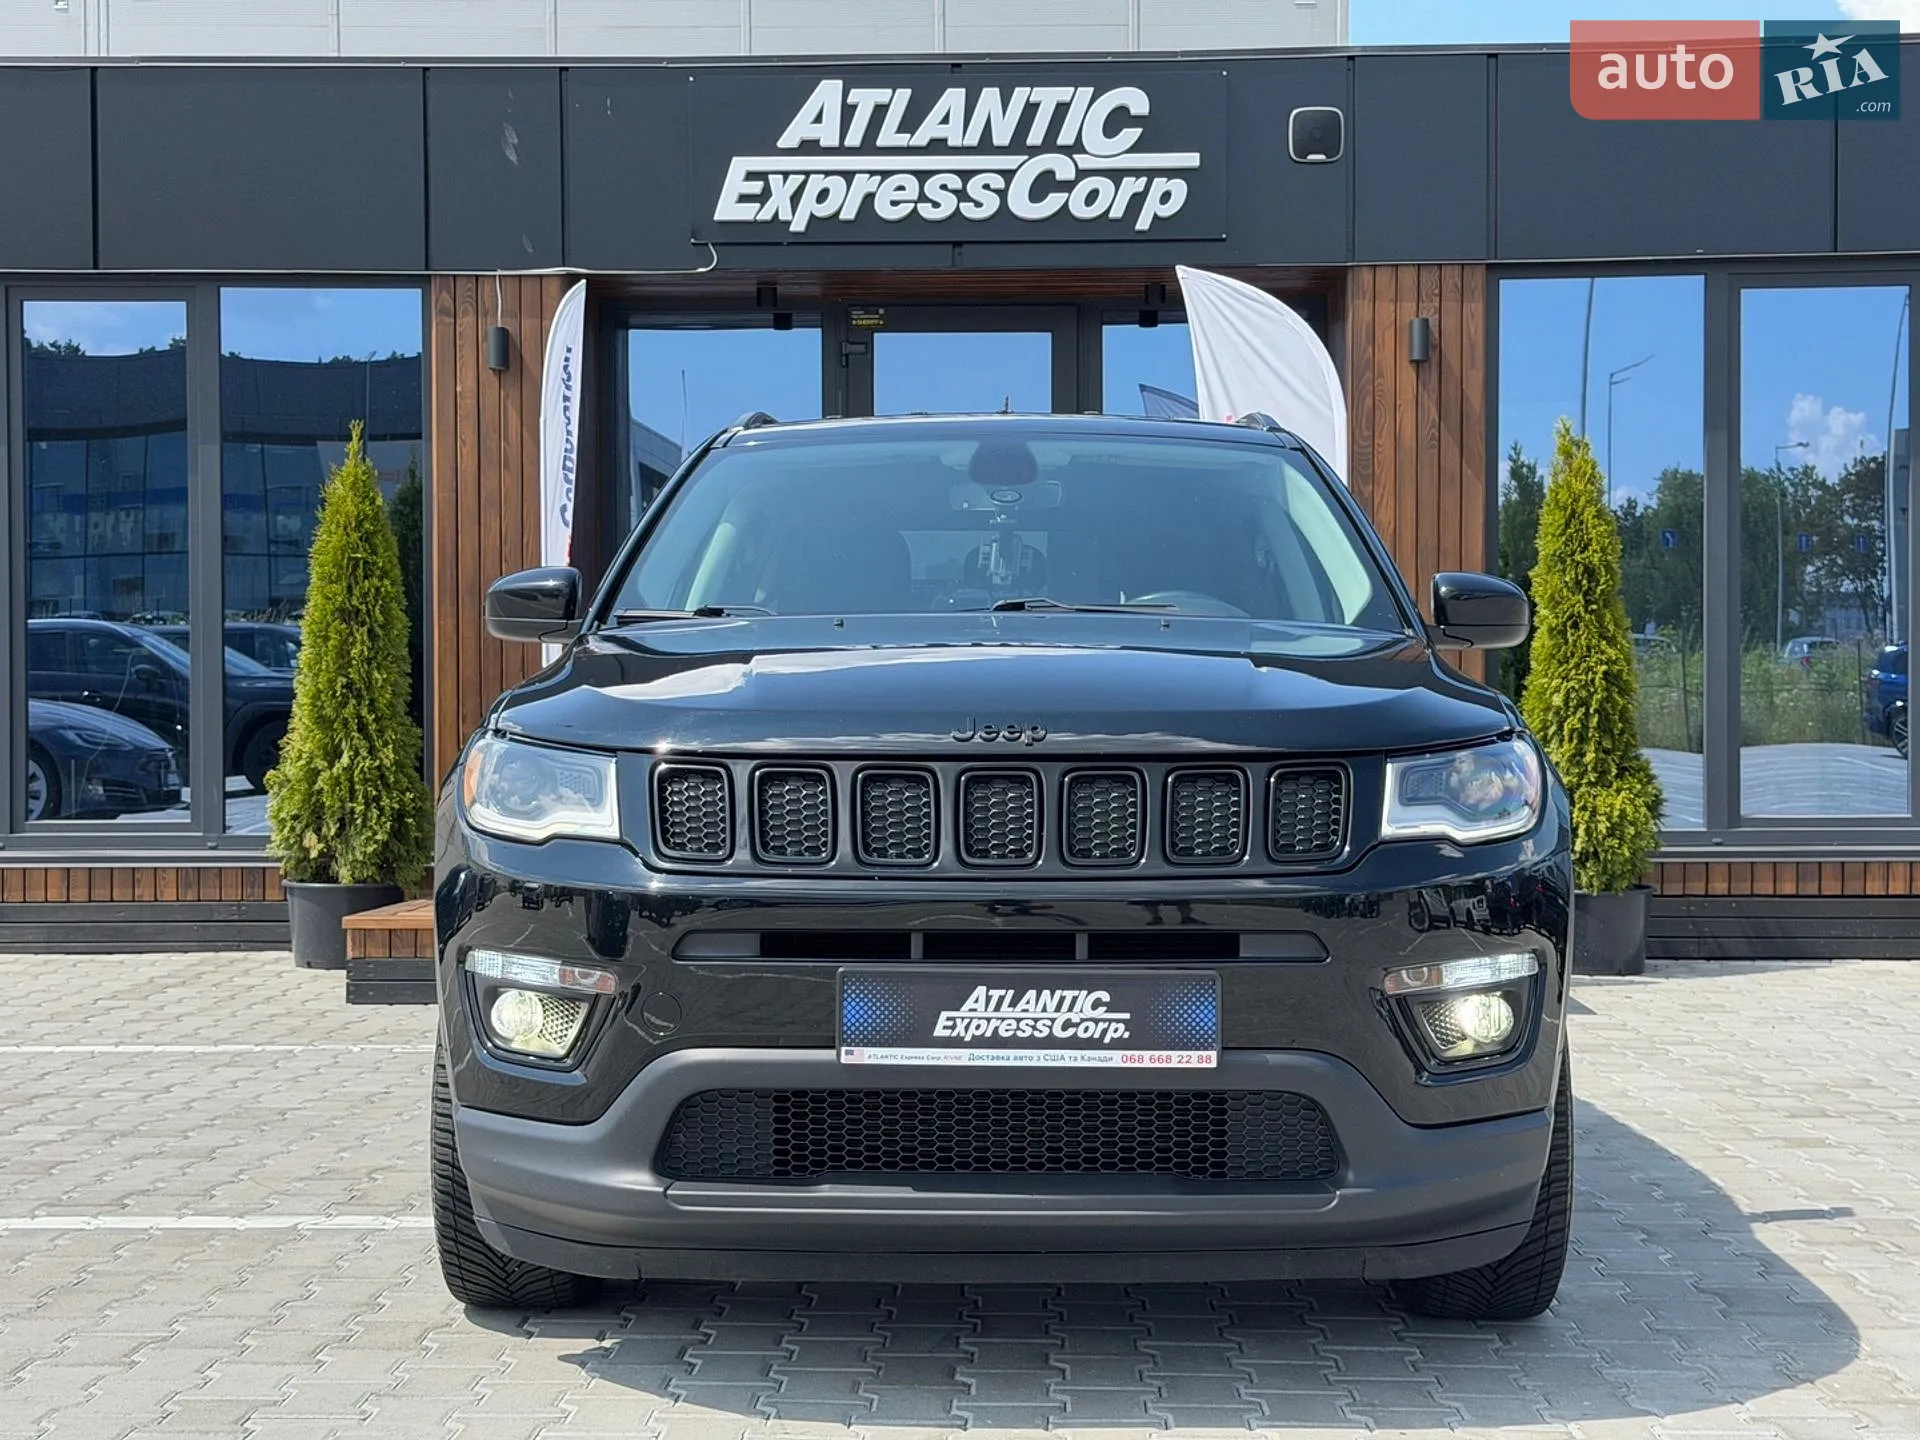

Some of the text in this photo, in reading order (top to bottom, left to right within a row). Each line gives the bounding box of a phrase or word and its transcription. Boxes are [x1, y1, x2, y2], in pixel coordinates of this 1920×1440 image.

[776, 79, 1150, 156] ATLANTIC
[951, 715, 1048, 746] Jeep
[959, 985, 1111, 1016] ATLANTIC
[968, 1053, 1011, 1062] Доставка
[1042, 1053, 1066, 1062] США
[1080, 1054, 1114, 1063] Канади
[1121, 1054, 1212, 1064] 068 668 22 88
